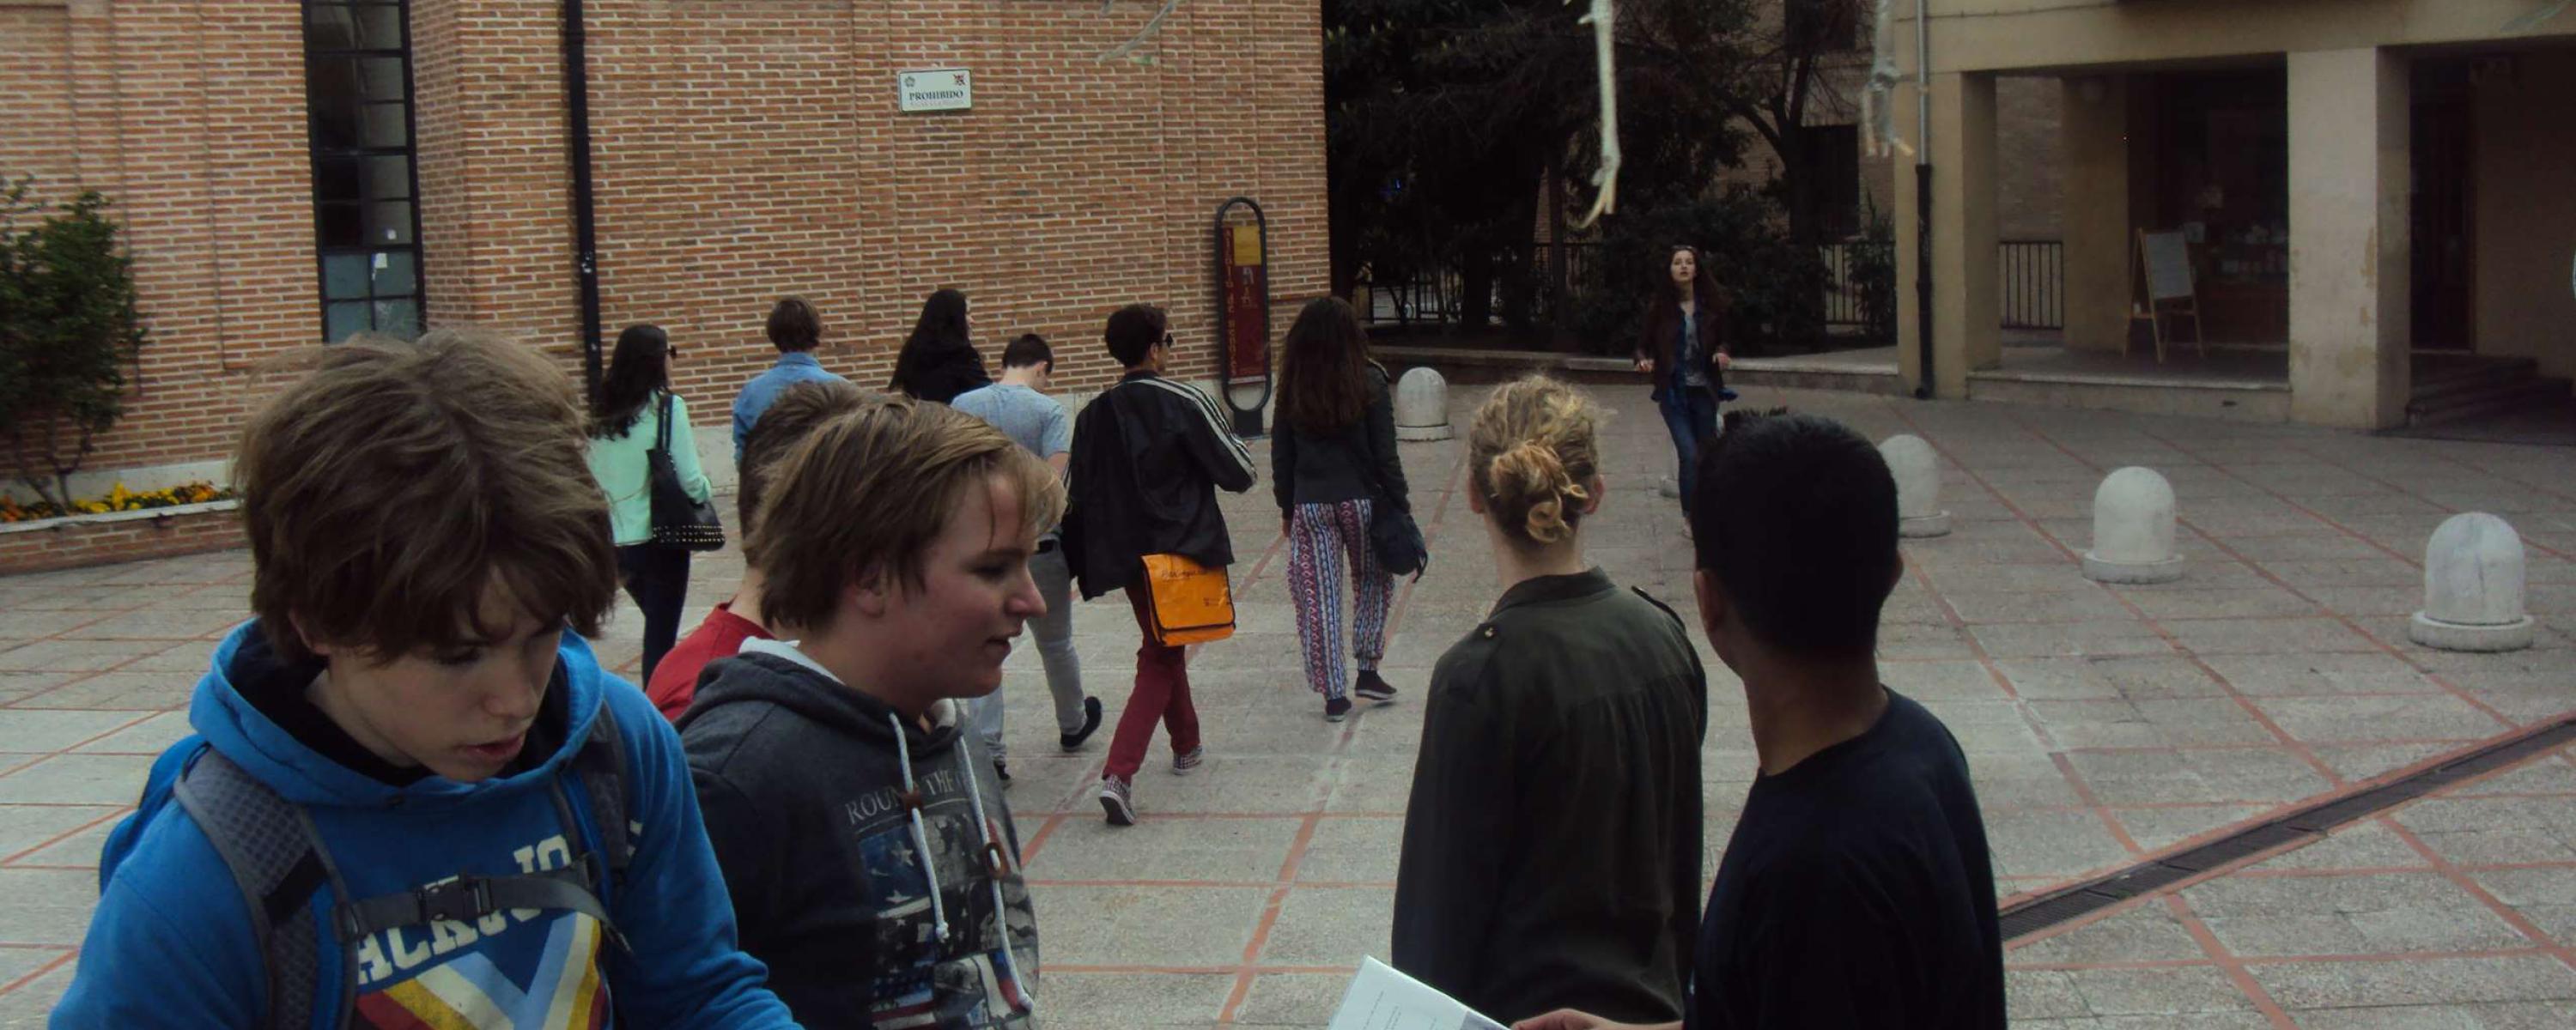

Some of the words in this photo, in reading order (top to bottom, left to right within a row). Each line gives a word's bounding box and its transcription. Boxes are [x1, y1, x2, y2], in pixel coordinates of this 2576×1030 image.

[909, 89, 963, 100] PROHIBIDO
[845, 785, 903, 825] ROUN
[921, 769, 955, 797] THE
